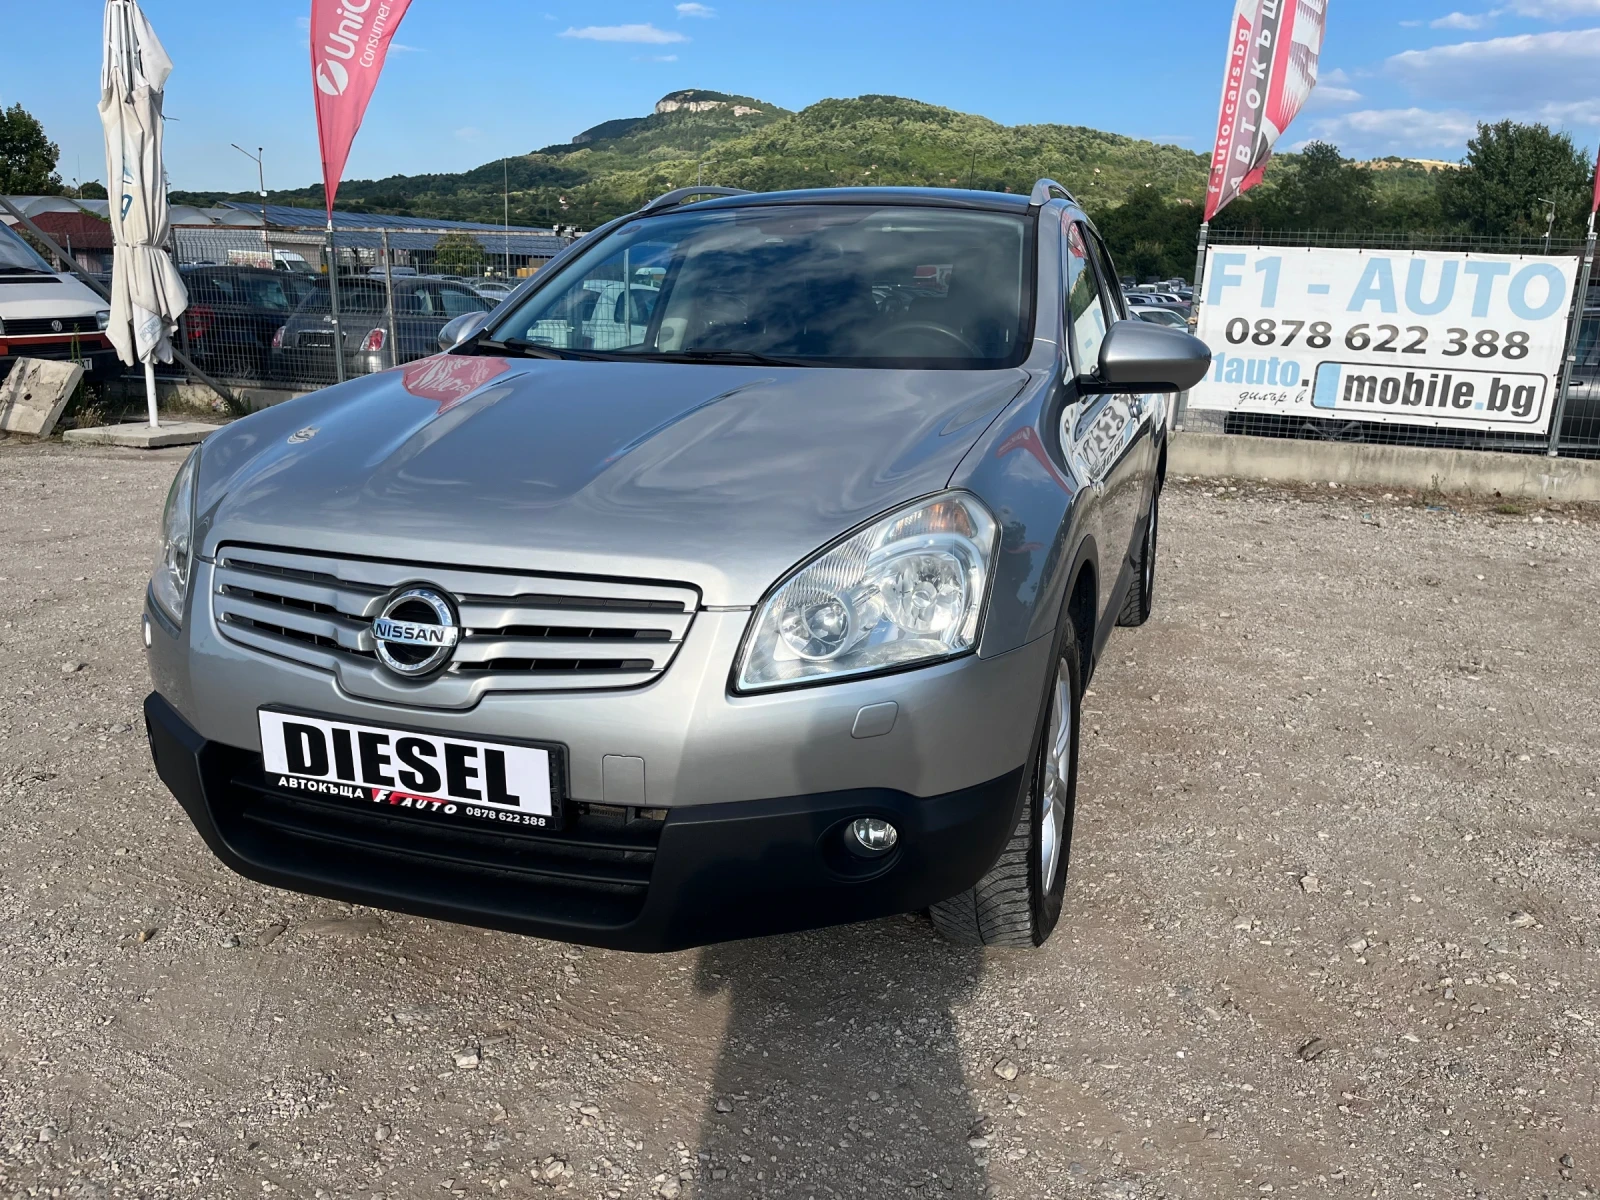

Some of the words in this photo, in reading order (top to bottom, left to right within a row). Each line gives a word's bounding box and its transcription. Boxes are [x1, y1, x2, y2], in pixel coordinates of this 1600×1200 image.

[359, 2, 391, 68] Consumer
[1206, 252, 1283, 308] F1
[1346, 256, 1567, 321] AUTO
[1225, 317, 1332, 349] 0878
[1344, 323, 1430, 355] 622
[1441, 327, 1531, 360] 388
[1238, 390, 1288, 405] дилър
[1342, 372, 1537, 417] mobile.bg
[374, 622, 445, 643] NISSAN
[282, 721, 520, 806] DIESEL
[278, 776, 365, 800] АВТОКЪЩА
[400, 797, 457, 814] AUTO
[465, 806, 496, 820] 0878
[499, 813, 520, 824] 622
[522, 815, 546, 827] 388
